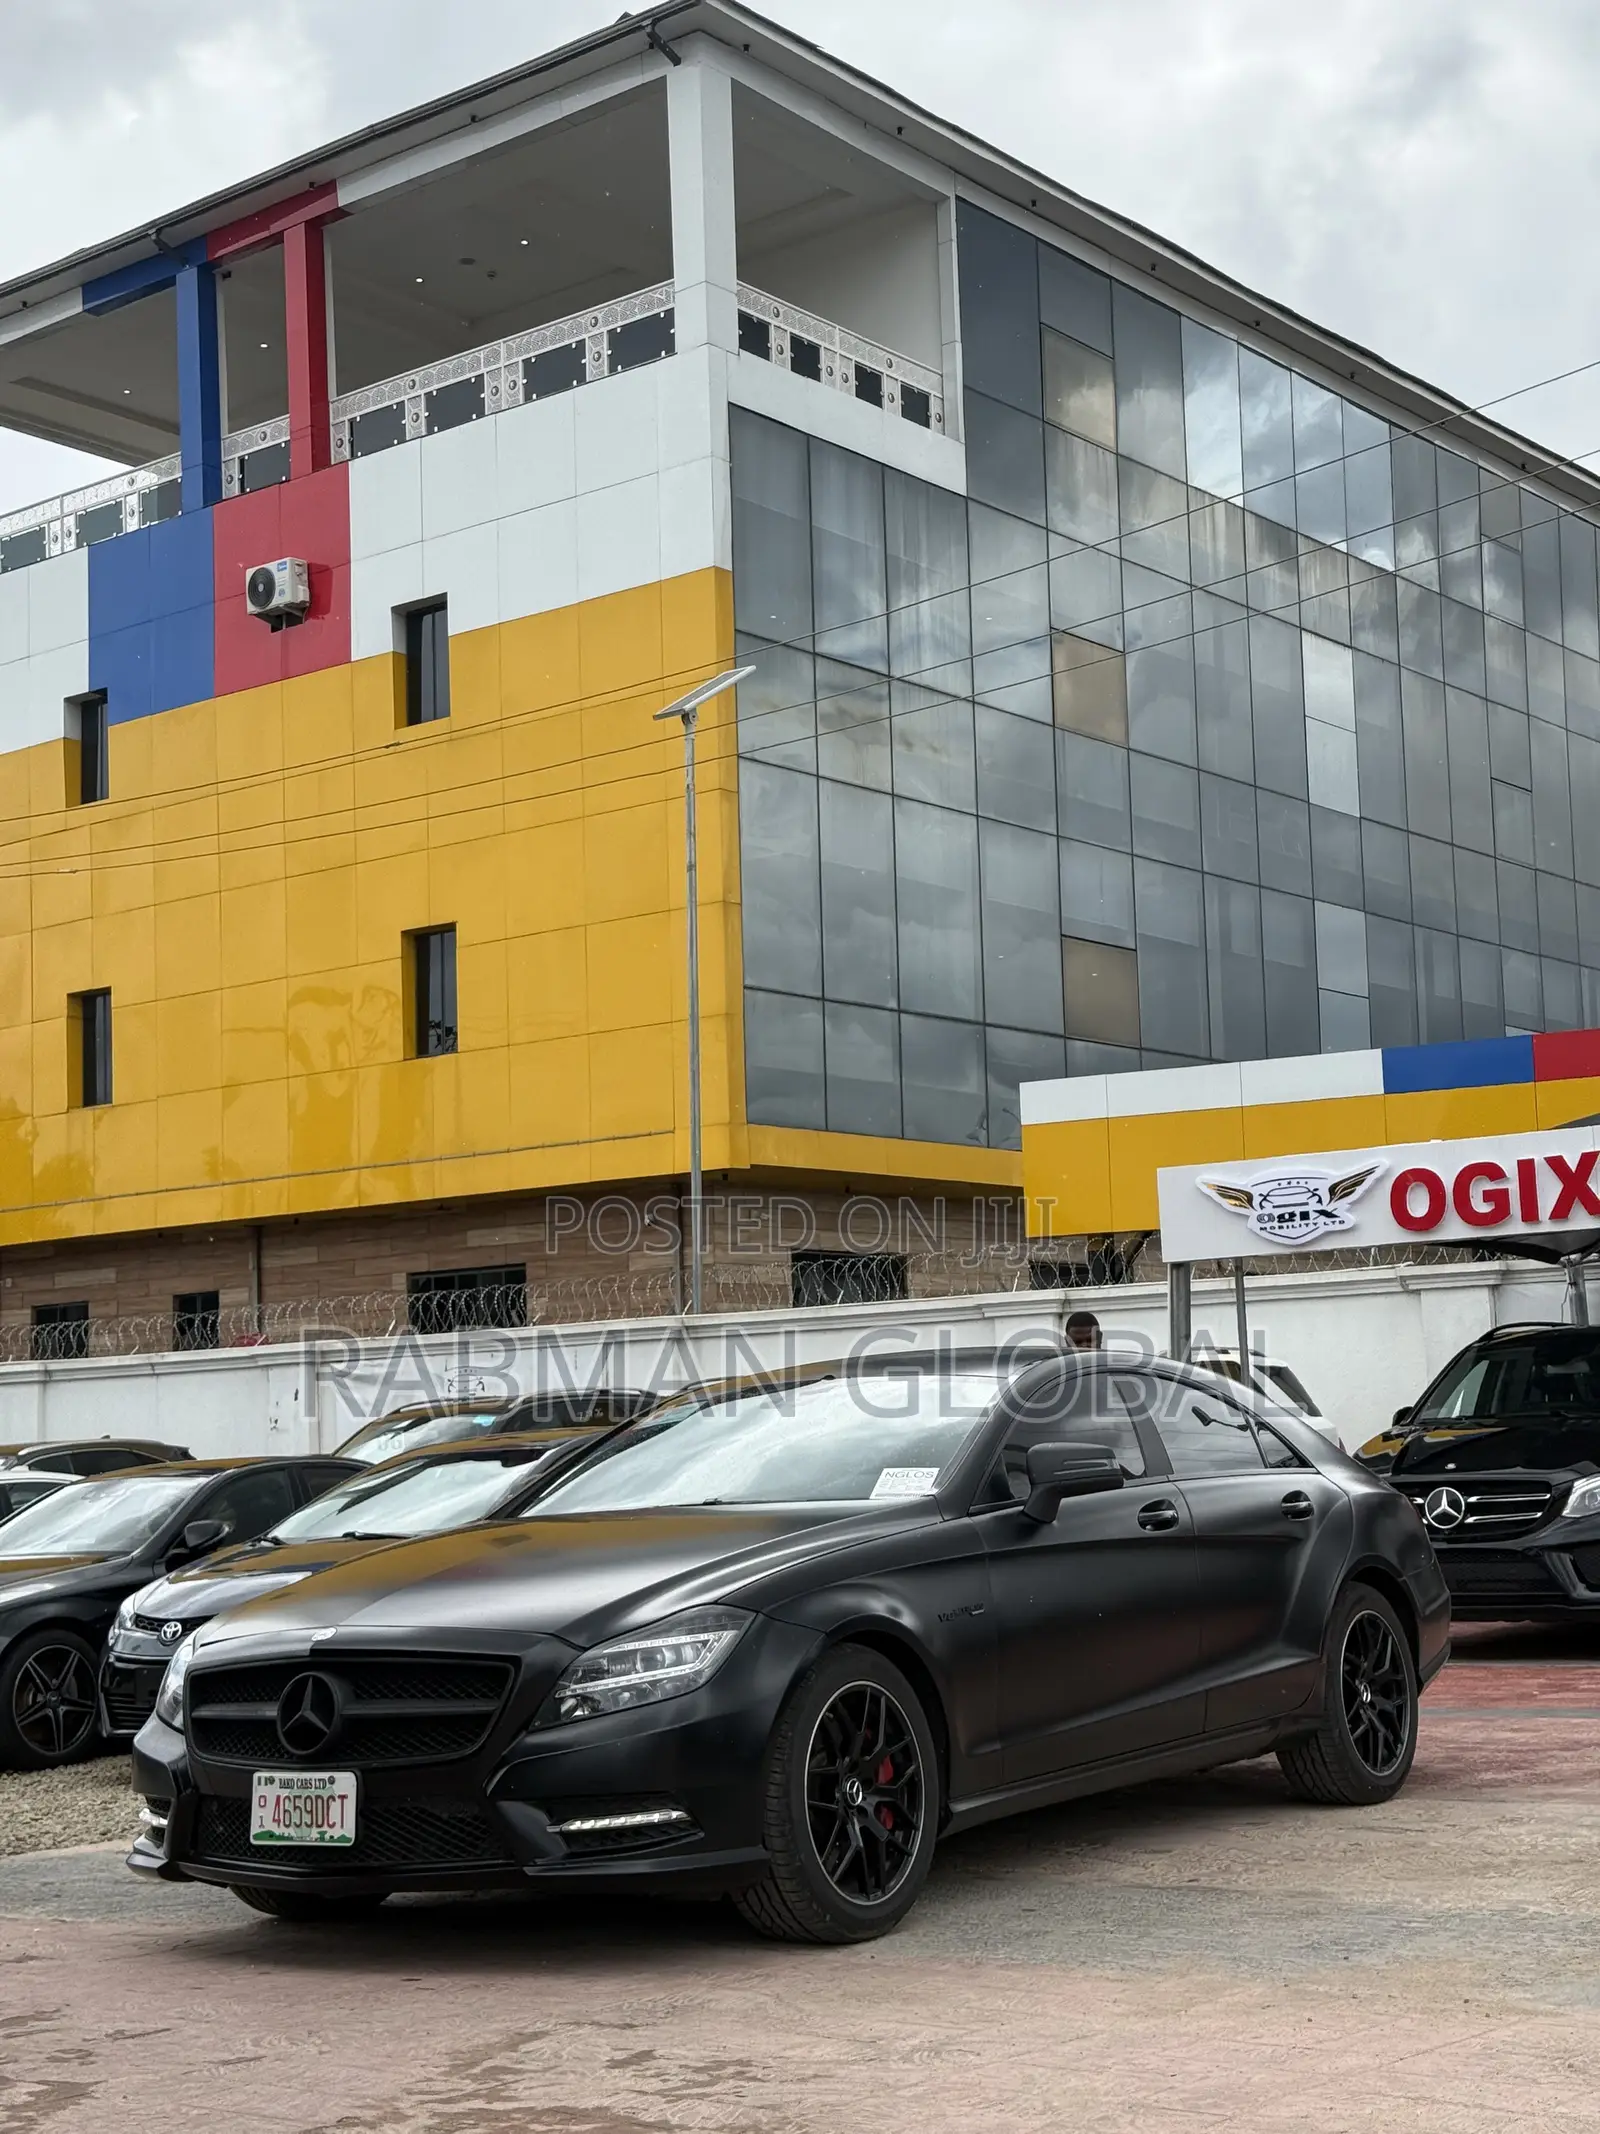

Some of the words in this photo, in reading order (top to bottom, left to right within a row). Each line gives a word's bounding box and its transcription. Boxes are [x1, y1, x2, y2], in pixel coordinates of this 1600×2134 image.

[1390, 1150, 1600, 1232] OGIX
[1259, 1222, 1319, 1231] MOBILITY
[314, 1778, 327, 1790] LTD
[272, 1794, 348, 1829] 4659DCT
